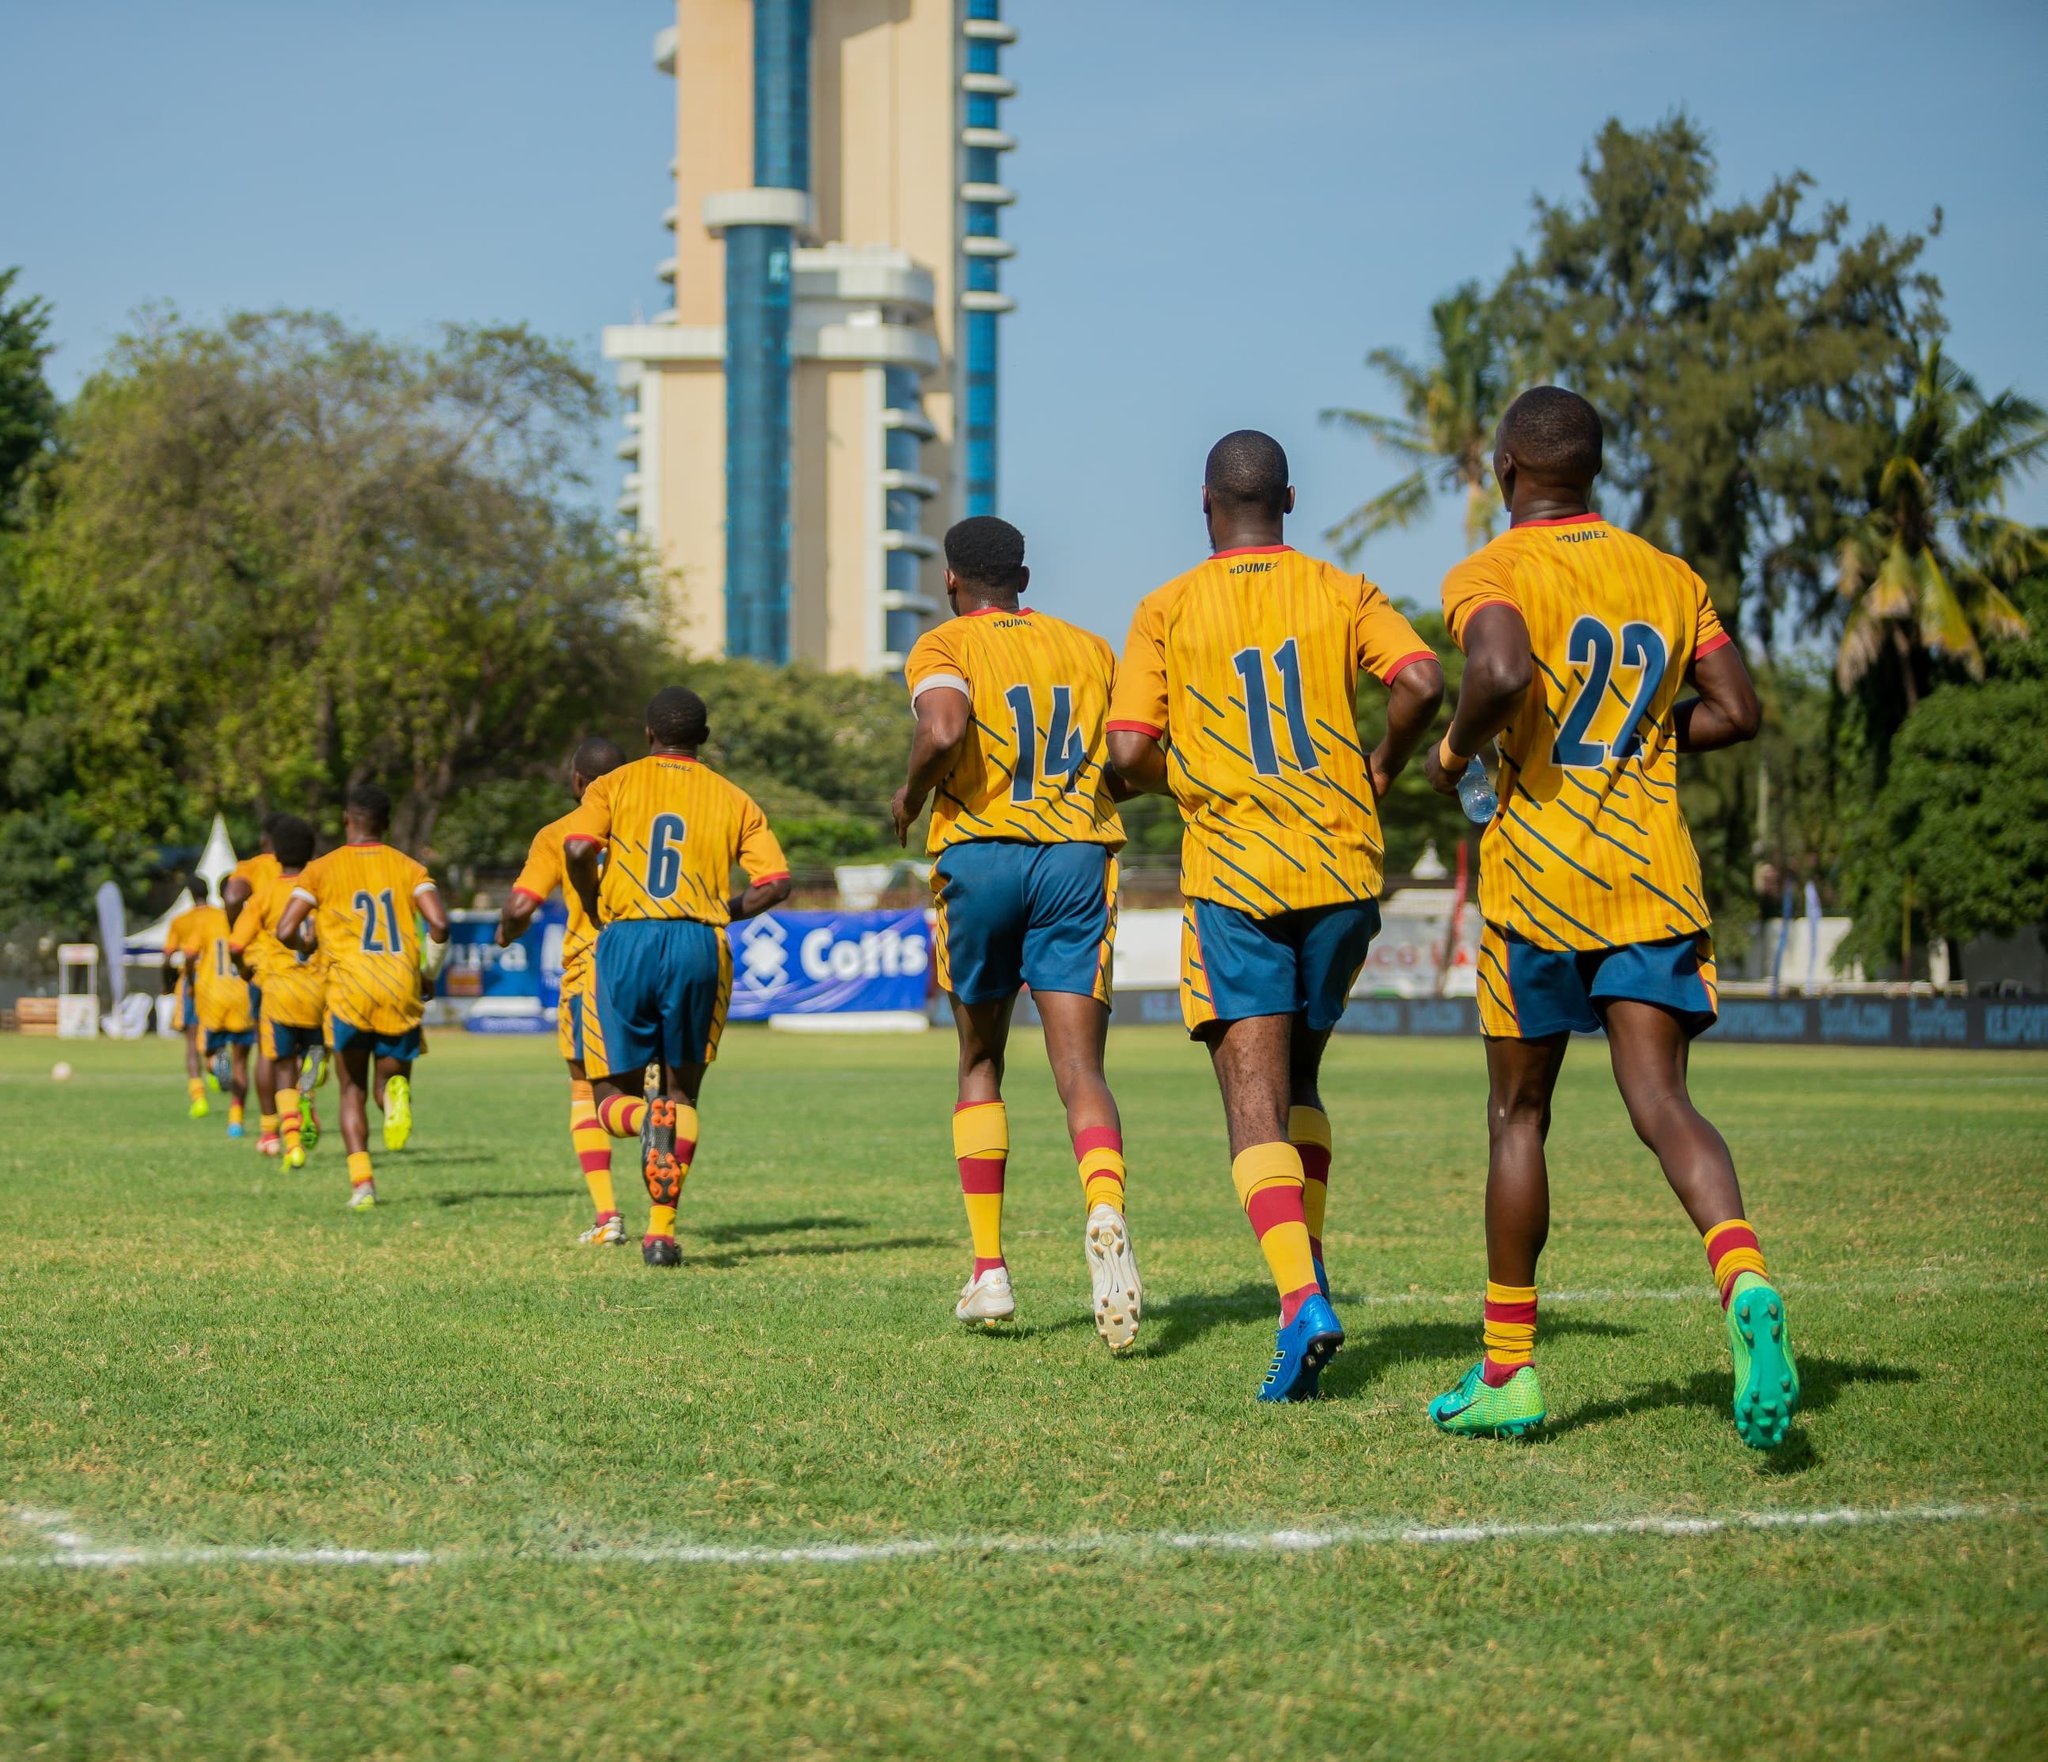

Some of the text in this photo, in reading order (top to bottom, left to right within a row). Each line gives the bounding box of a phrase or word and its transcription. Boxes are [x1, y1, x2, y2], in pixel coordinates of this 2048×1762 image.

[1004, 683, 1088, 803] 14
[1231, 632, 1321, 777] 11
[1551, 614, 1669, 768] 22
[646, 811, 687, 900] 6
[352, 888, 404, 954] 21
